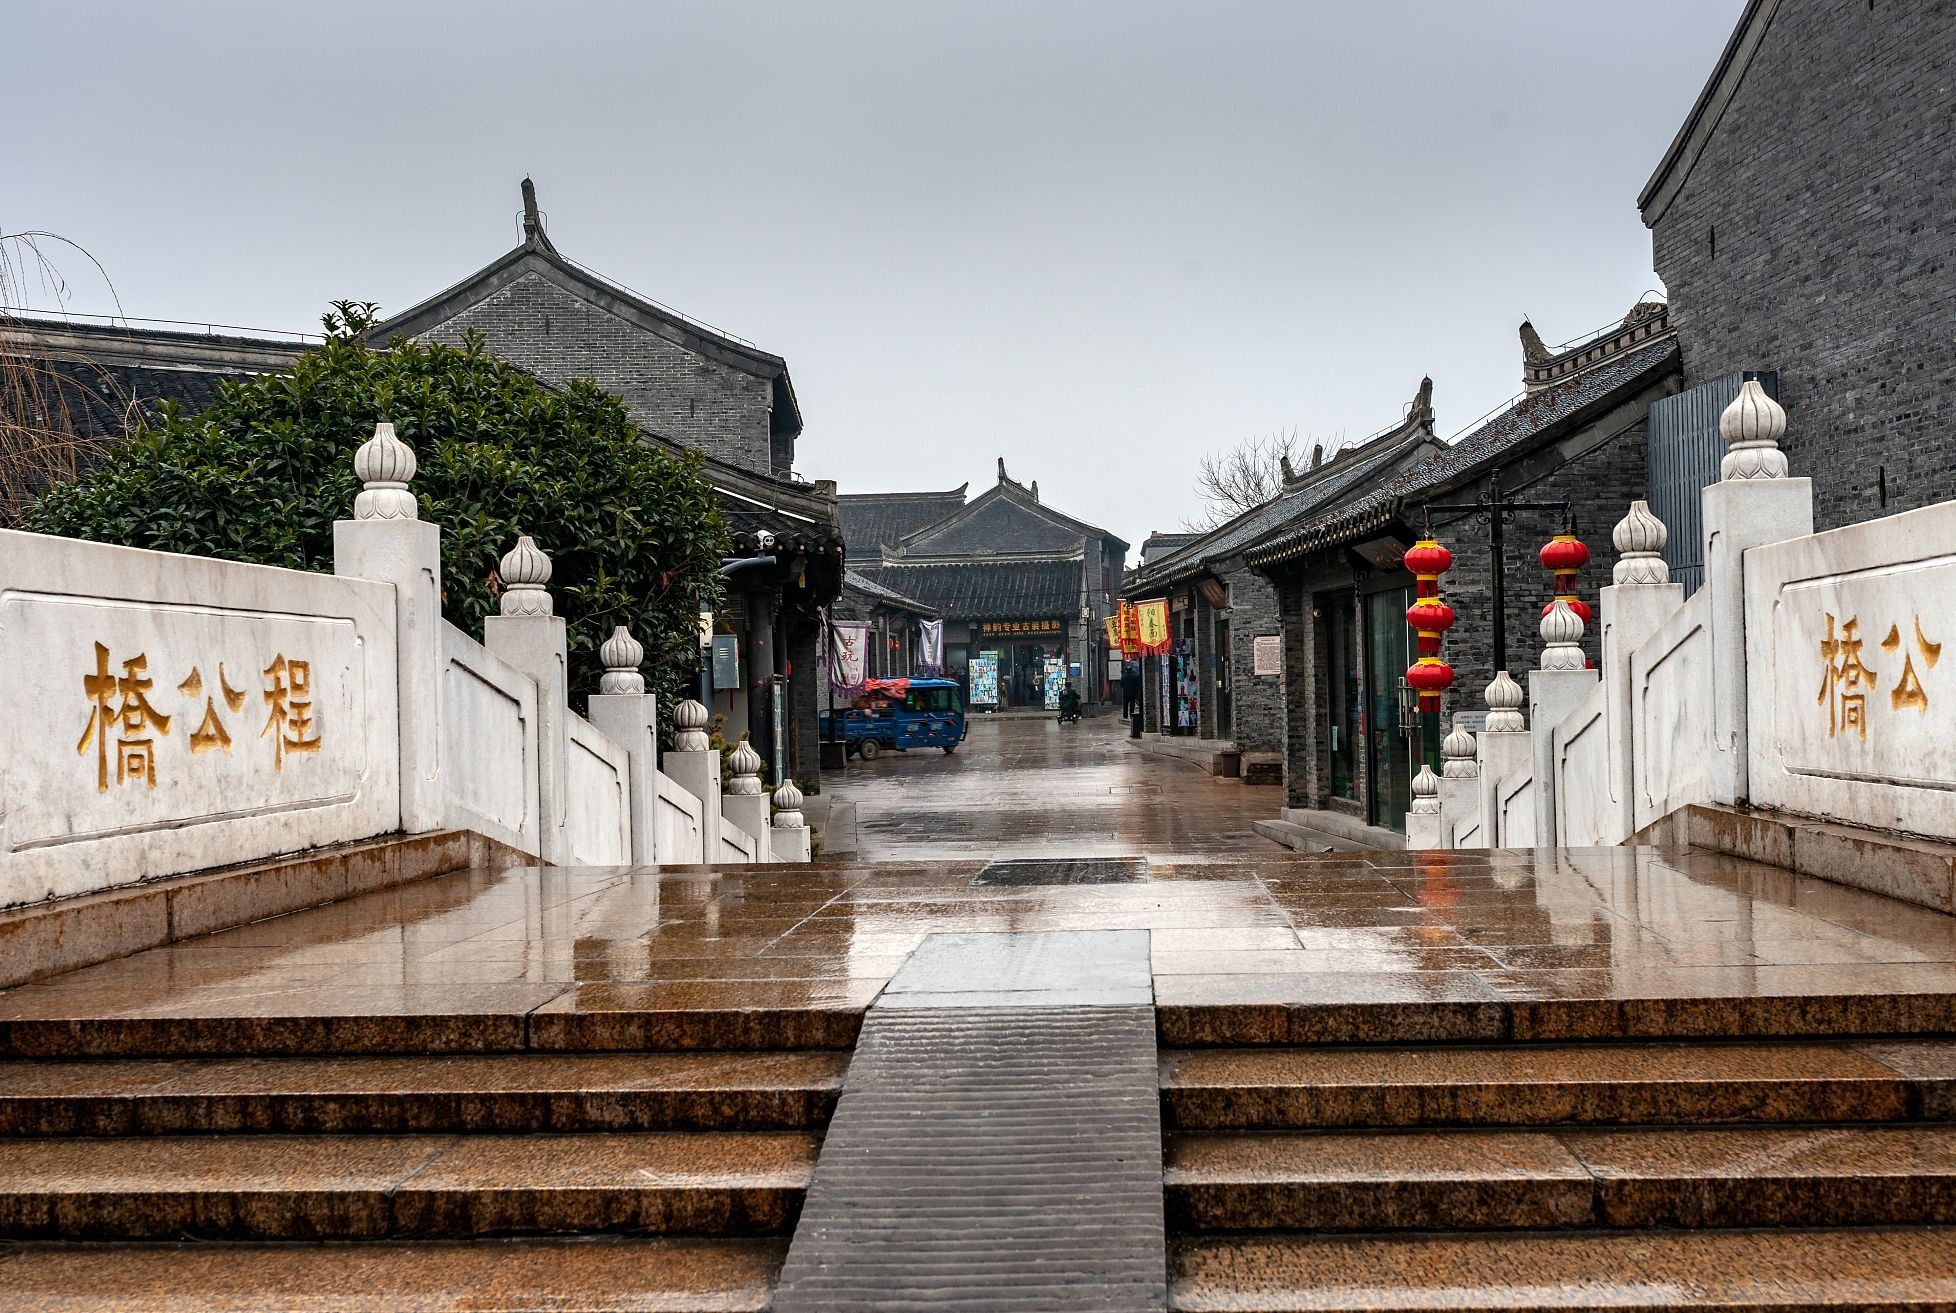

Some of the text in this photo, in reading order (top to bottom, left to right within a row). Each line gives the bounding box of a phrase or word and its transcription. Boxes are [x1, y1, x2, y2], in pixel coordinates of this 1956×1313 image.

[1146, 608, 1158, 638] 阳春面
[841, 635, 859, 662] 古玩
